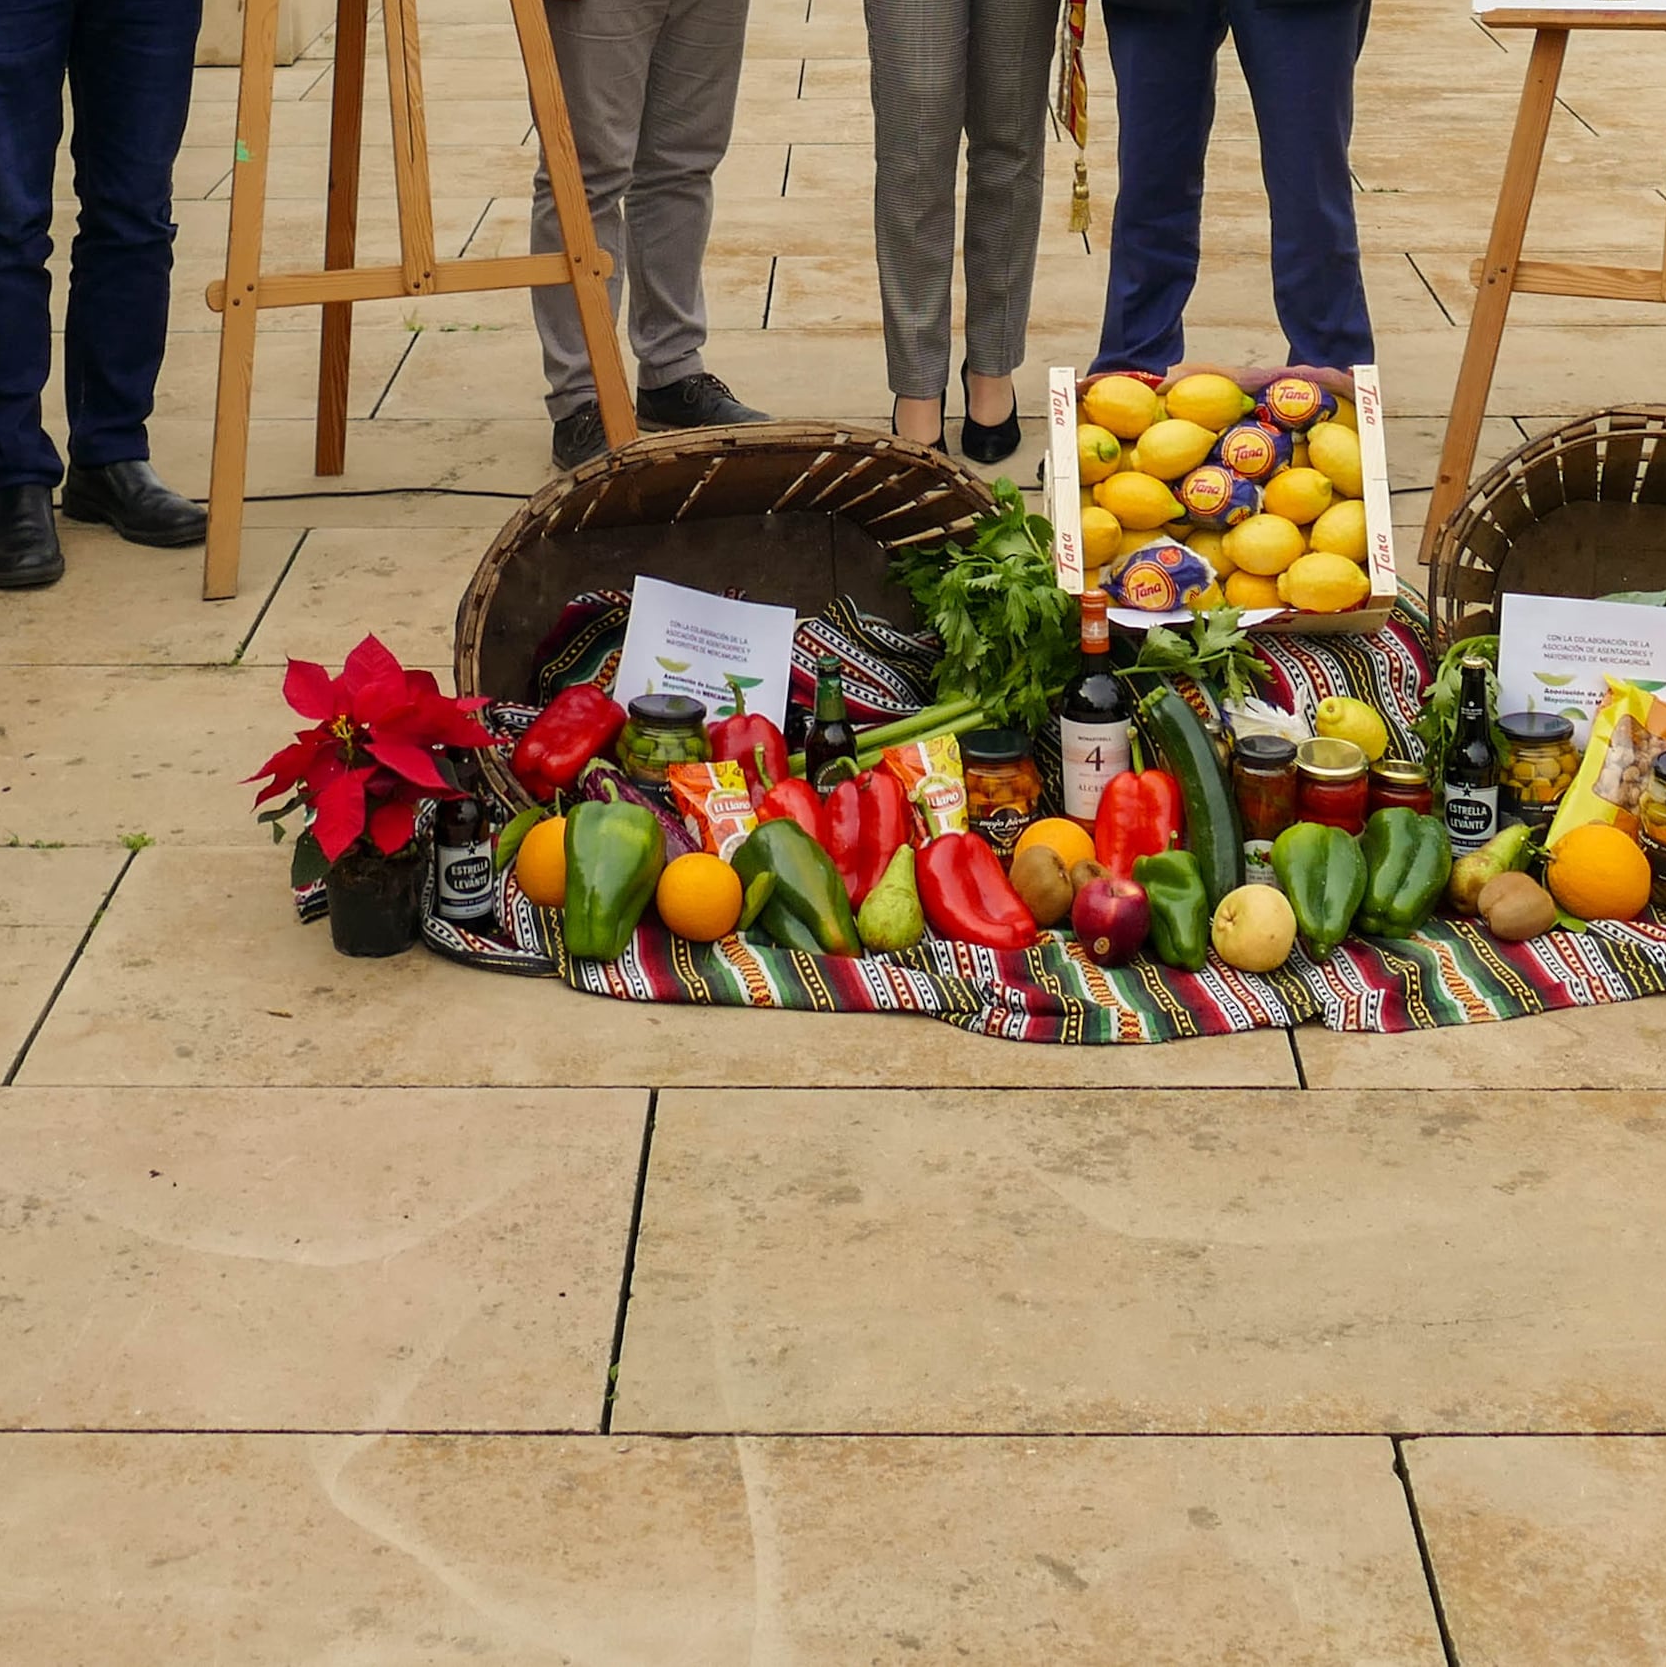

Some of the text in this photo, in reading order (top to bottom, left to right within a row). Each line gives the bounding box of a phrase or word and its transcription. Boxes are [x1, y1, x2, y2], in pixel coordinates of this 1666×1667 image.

[1279, 386, 1310, 401] Tana
[1051, 387, 1070, 426] Tana
[1357, 385, 1379, 426] Tana
[1234, 445, 1264, 463] Tana
[1191, 479, 1221, 495] Tana
[1057, 532, 1080, 574] Tana
[1372, 533, 1395, 575] Tana
[1132, 581, 1162, 602] Tana
[1089, 621, 1100, 633] 4
[1542, 643, 1584, 653] ASOCIACIÓN
[1574, 635, 1628, 646] COLABORACIÓN
[1544, 653, 1586, 662] MAYORISTAS
[1599, 656, 1650, 666] MERCAMURCIA
[1544, 687, 1585, 696] Asociación
[1084, 745, 1105, 772] 4
[725, 800, 751, 813] Llano
[1449, 802, 1488, 817] ESTRELLA
[1450, 817, 1485, 830] LEVANTE
[451, 860, 489, 876] ESTRELLA
[453, 874, 487, 890] LEVANTE
